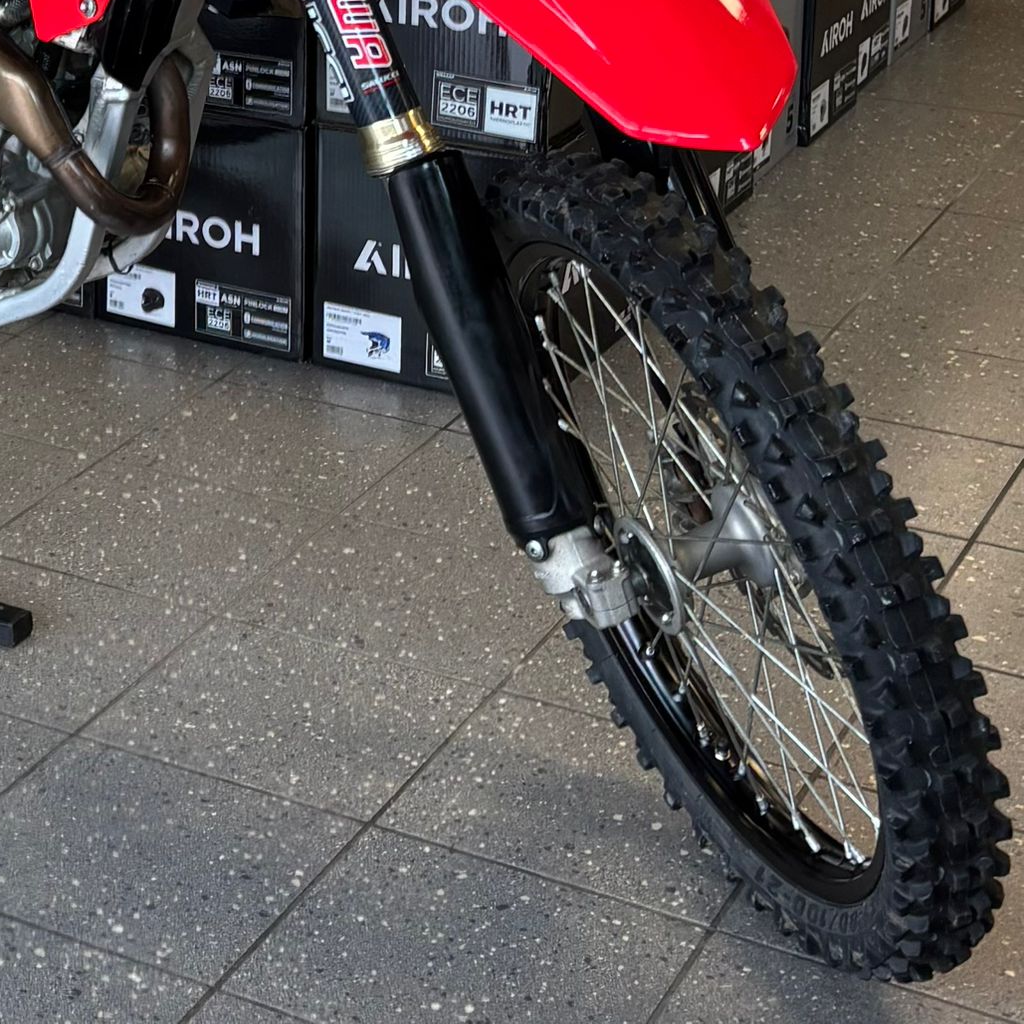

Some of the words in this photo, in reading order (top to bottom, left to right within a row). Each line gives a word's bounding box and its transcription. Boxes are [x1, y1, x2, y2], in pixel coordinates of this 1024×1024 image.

[820, 11, 854, 58] AIROH
[222, 60, 242, 73] ASN
[440, 82, 478, 105] ECE
[441, 102, 476, 117] 2206
[490, 101, 531, 120] HRT
[165, 209, 260, 256] ROH
[221, 293, 241, 307] ASN
[208, 308, 231, 320] ECE
